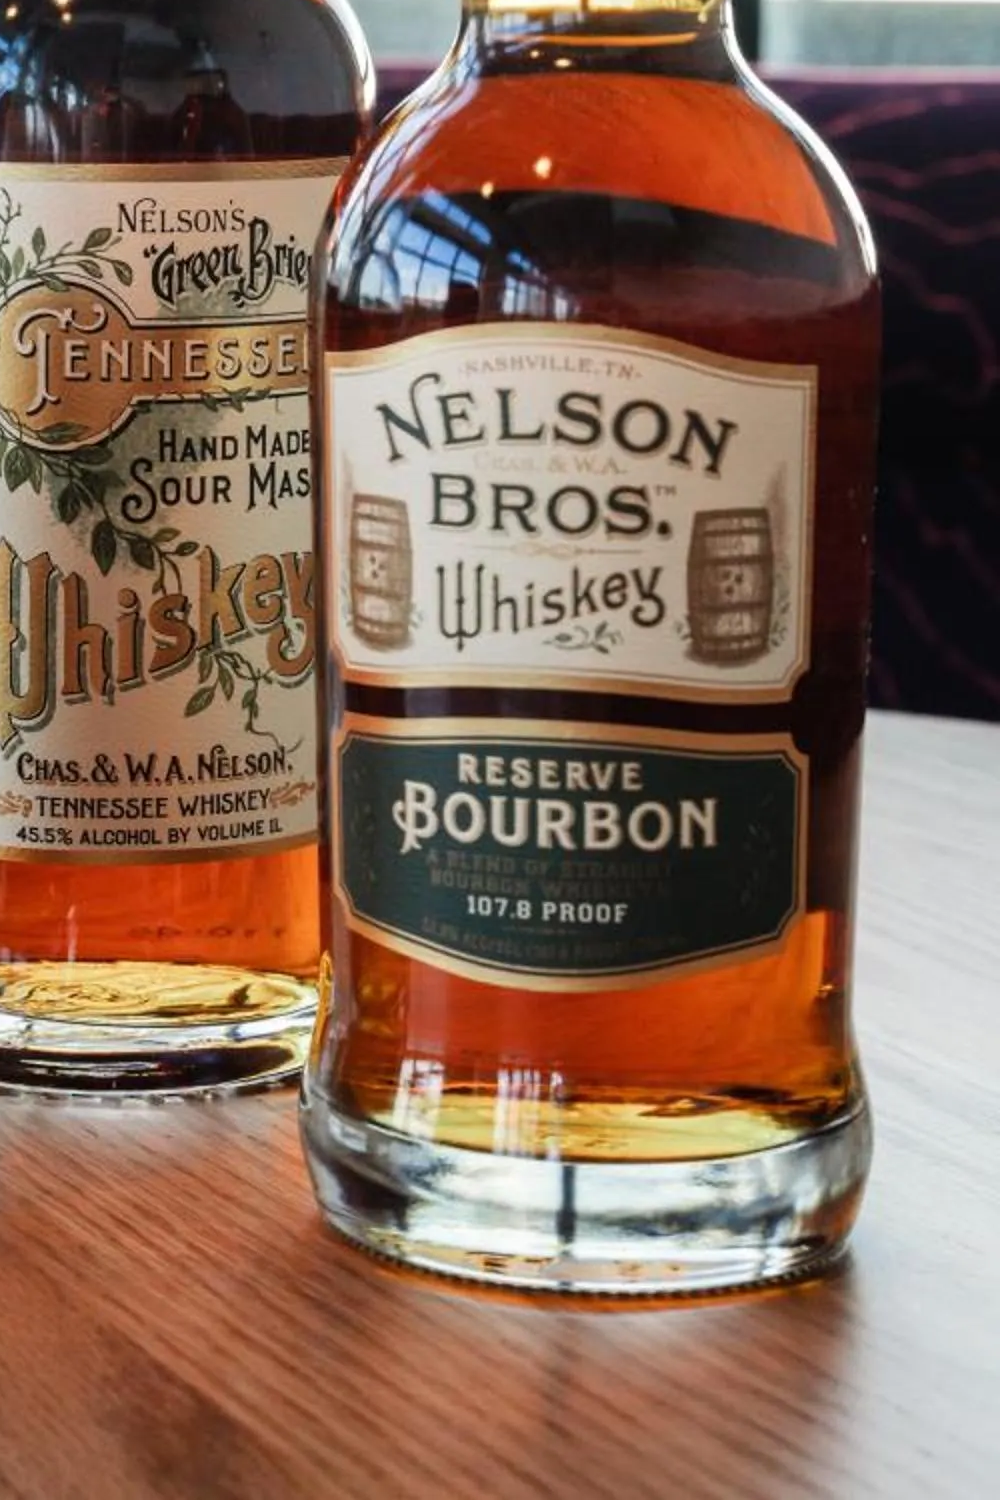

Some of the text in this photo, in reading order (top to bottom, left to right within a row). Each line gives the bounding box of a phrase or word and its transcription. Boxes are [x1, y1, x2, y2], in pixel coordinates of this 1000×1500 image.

[116, 197, 246, 234] NELSON'S
[158, 424, 311, 463] HAND MADE
[375, 371, 740, 479] NELSON
[121, 457, 232, 522] SOUR
[429, 471, 673, 541] BROS.
[435, 559, 668, 653] Whiskey
[16, 751, 89, 784] CHAS.
[90, 751, 119, 784] &
[196, 744, 294, 781] NELSON.
[457, 753, 645, 792] RESERVE
[36, 787, 272, 820] TENNESSEE WHISKEY
[392, 779, 720, 855] BOURBON
[16, 826, 73, 846] 45.5%
[79, 829, 162, 846] ALCOHOL
[168, 827, 192, 844] BY
[197, 819, 265, 842] VOLUME
[465, 894, 631, 925] 107.8 PROOF
